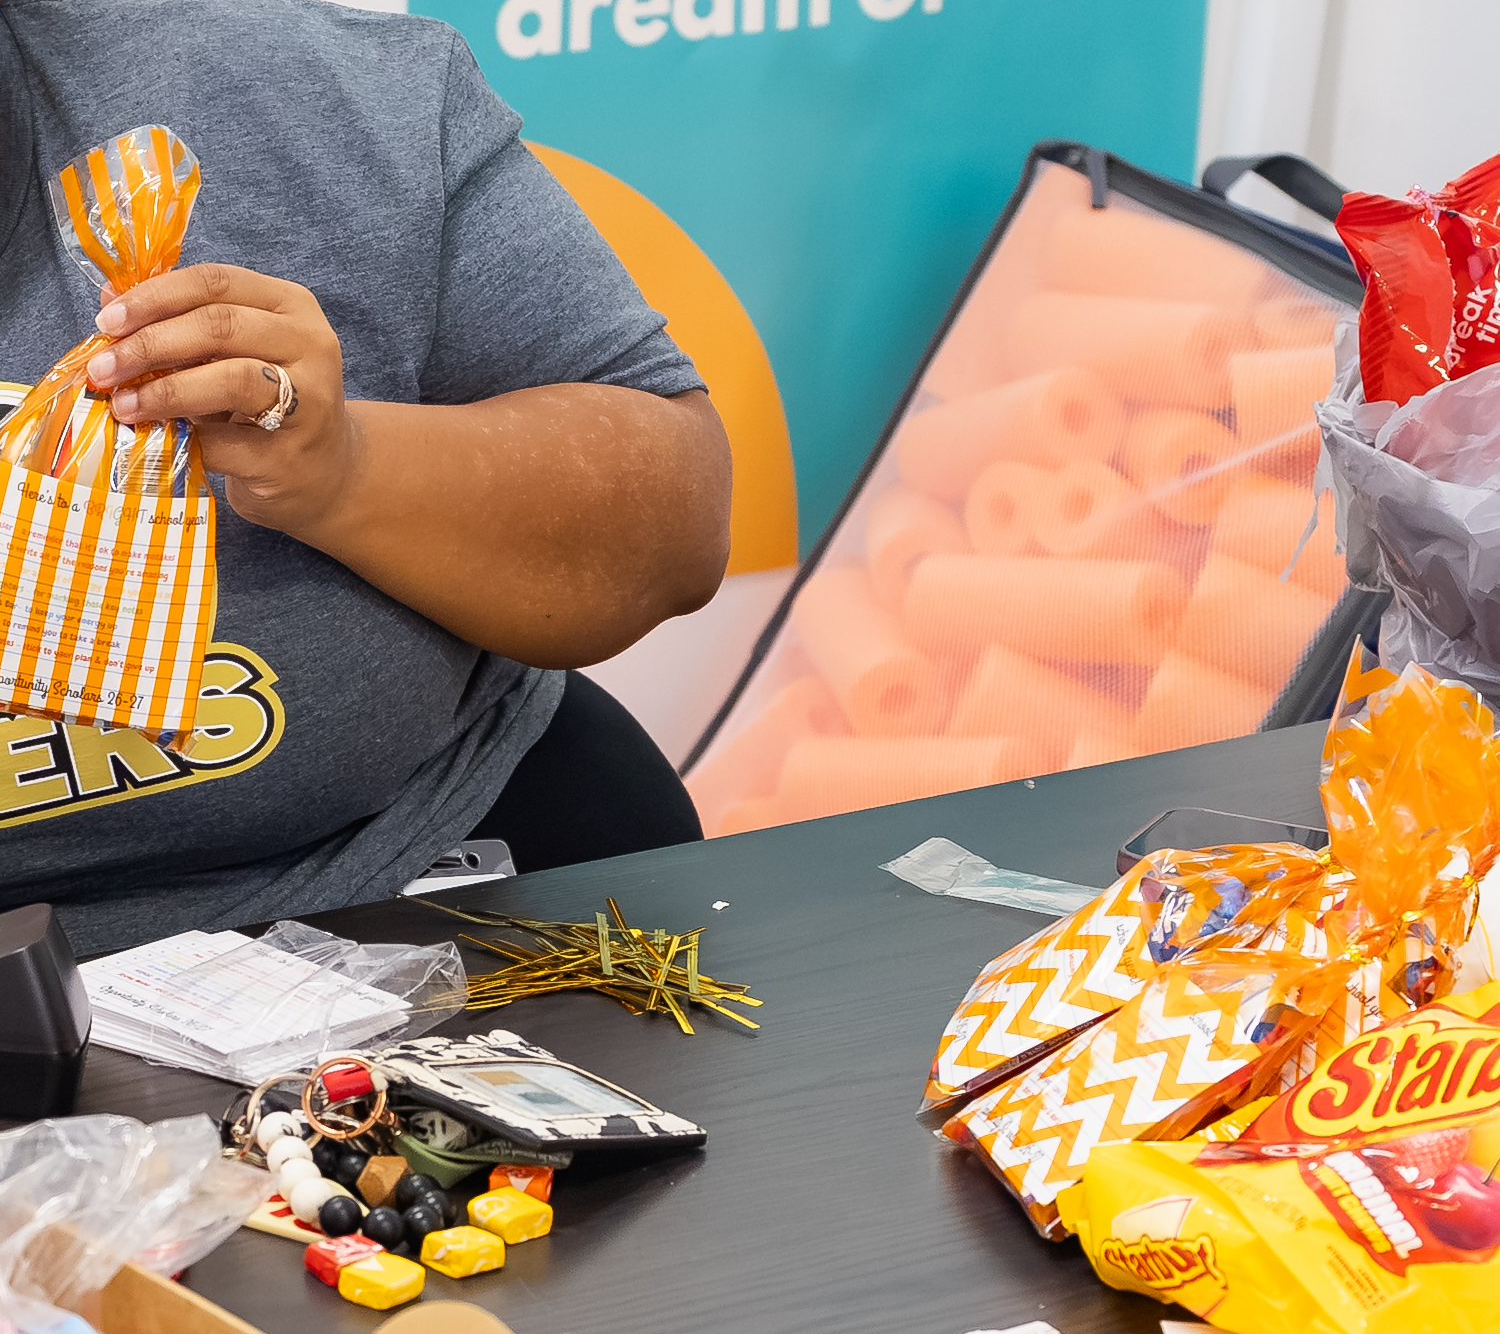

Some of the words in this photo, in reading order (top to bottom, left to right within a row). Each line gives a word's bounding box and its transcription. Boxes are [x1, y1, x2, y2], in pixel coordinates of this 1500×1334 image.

[17, 481, 53, 505] Here's
[57, 494, 70, 509] to
[71, 503, 80, 512] a
[148, 509, 183, 525] school
[52, 681, 103, 703] Scholars
[106, 691, 144, 710] 26-27
